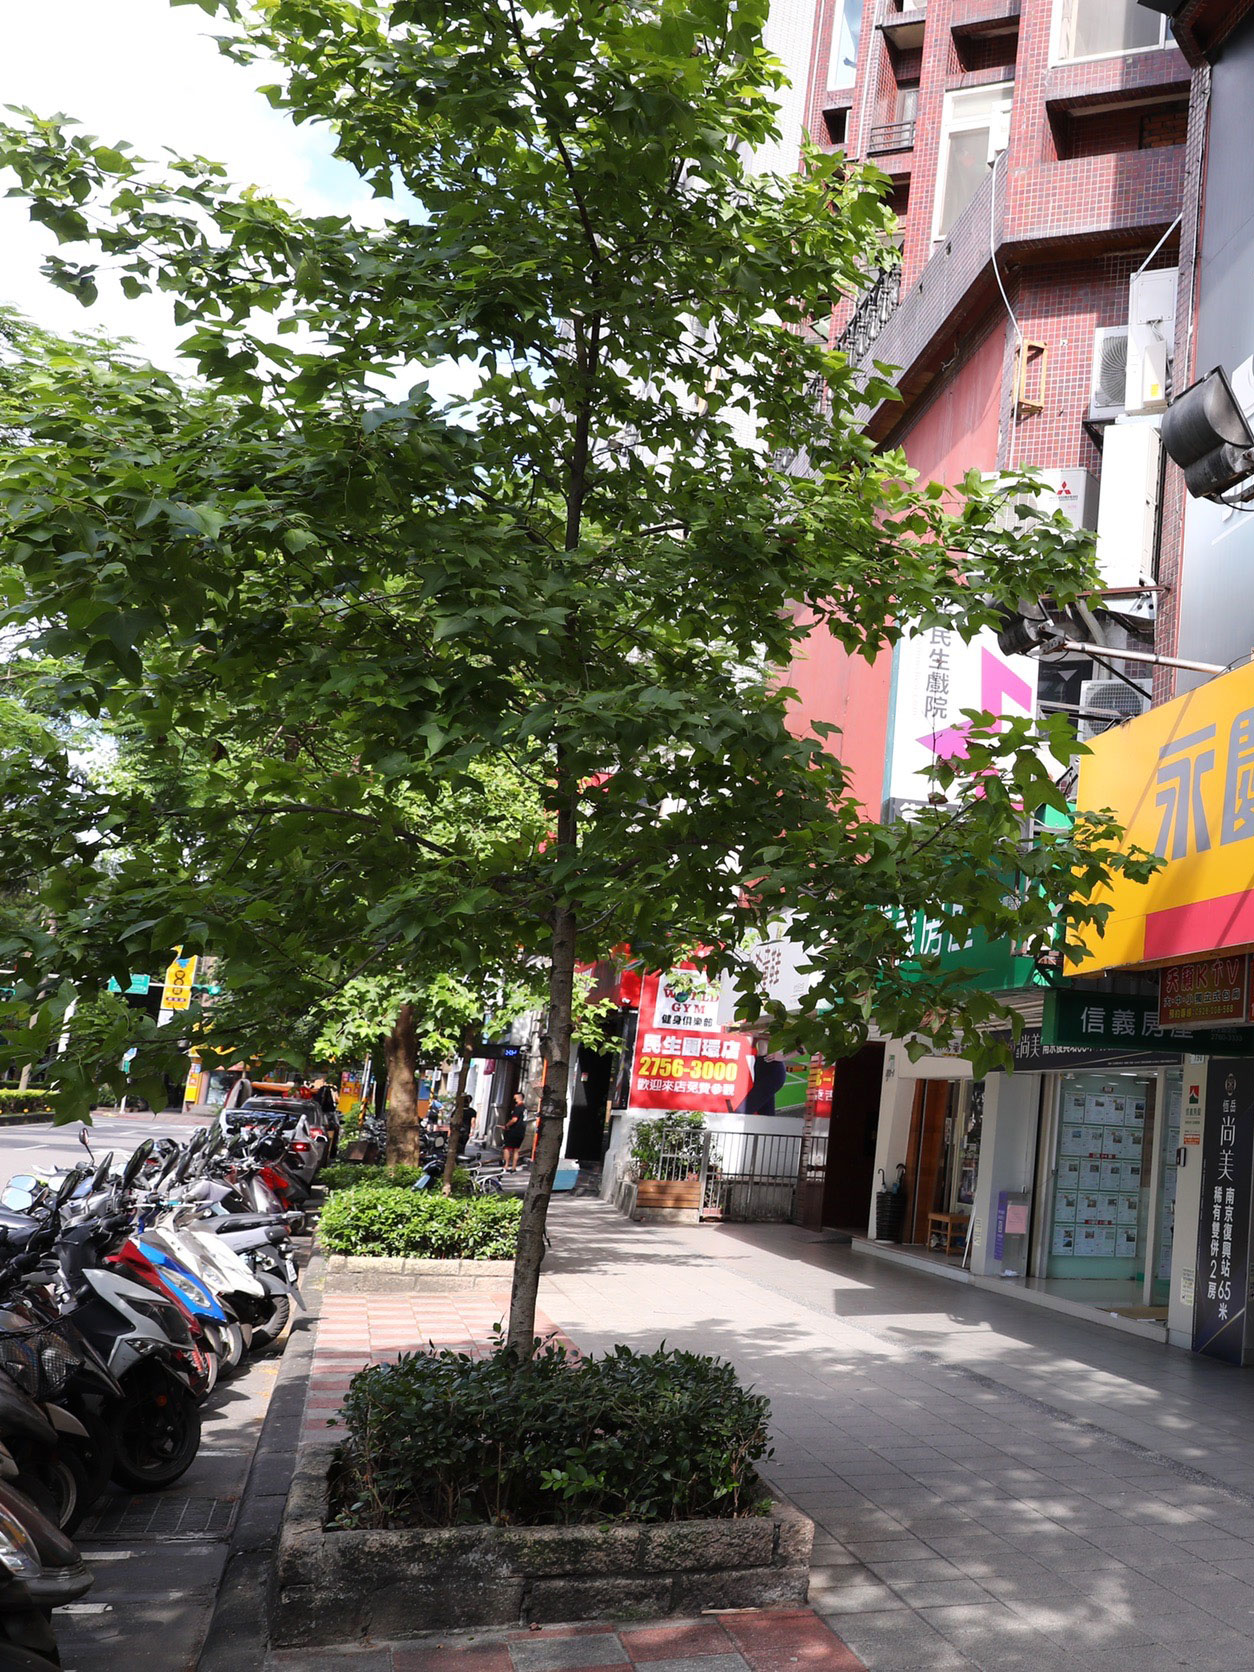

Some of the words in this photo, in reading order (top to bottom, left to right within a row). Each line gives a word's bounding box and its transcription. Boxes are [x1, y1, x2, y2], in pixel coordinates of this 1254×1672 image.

[924, 607, 952, 720] 民生戲院
[671, 1002, 705, 1014] GYM
[641, 1033, 741, 1060] 民生圓環店
[638, 1056, 738, 1082] 2756-3000
[1217, 1115, 1236, 1182] 尚美
